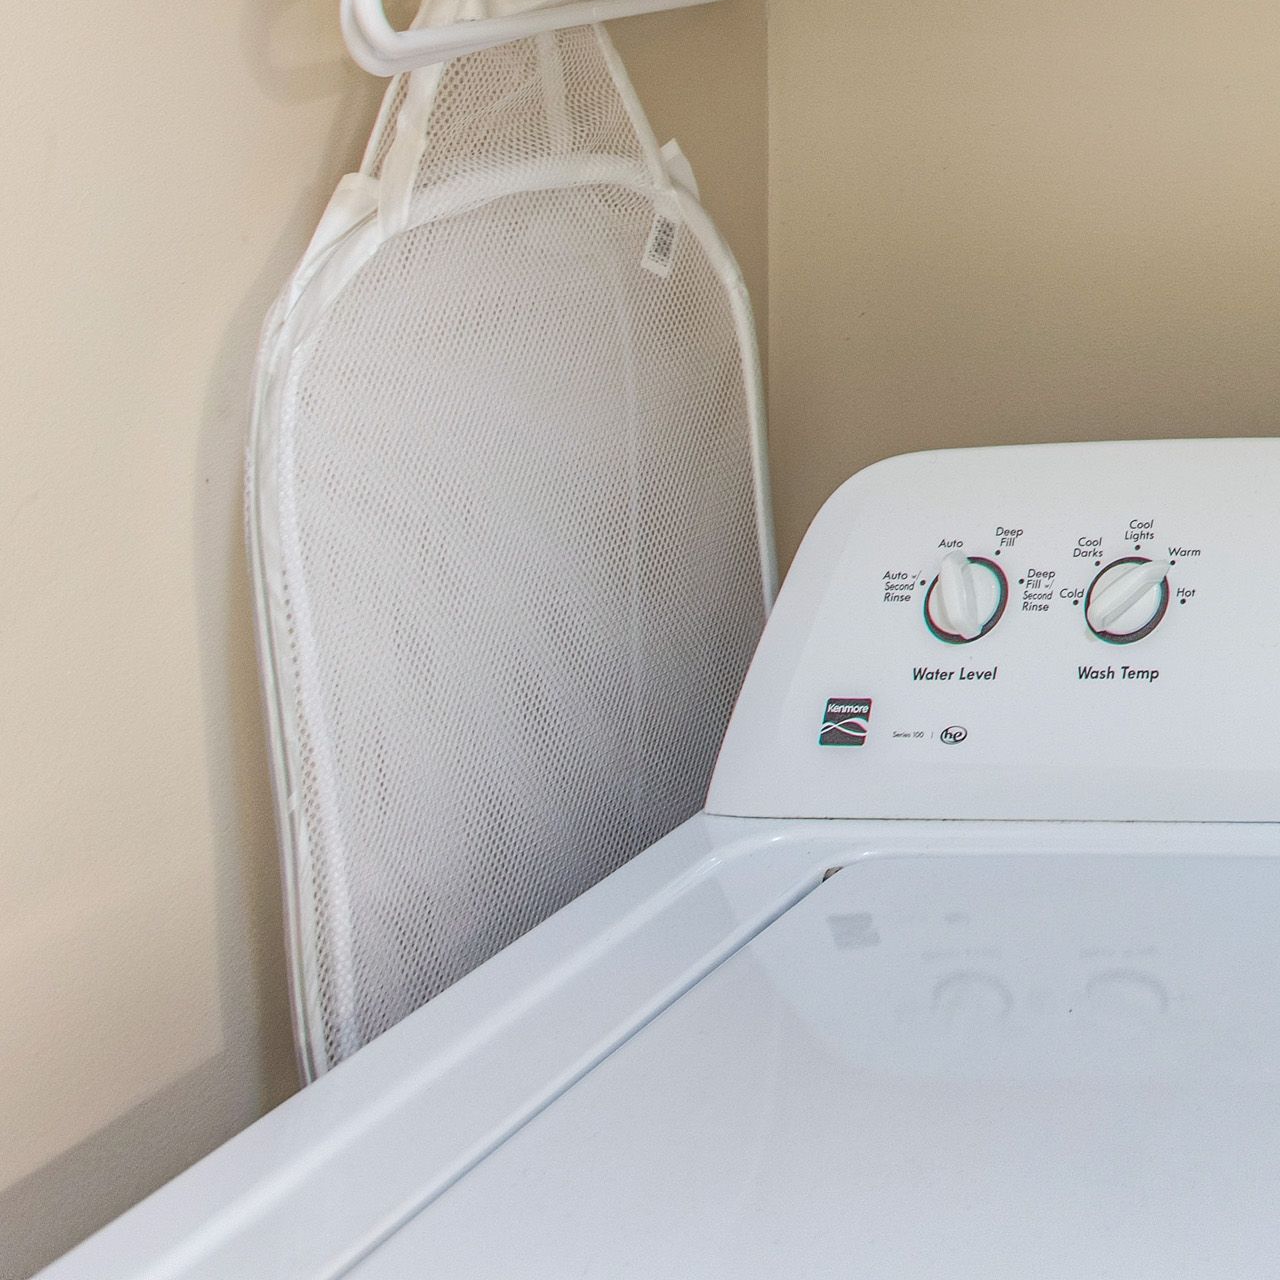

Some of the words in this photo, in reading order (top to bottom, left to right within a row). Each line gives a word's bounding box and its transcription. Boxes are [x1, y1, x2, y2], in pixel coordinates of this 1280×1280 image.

[1129, 519, 1155, 530] Cool
[995, 526, 1024, 539] Deep
[1124, 531, 1155, 543] Lights
[937, 538, 964, 548] Auto
[1000, 537, 1016, 547] Fill
[1078, 536, 1102, 547] Cool
[1072, 547, 1104, 558] Darks
[1167, 547, 1201, 556] Warm
[882, 570, 908, 580] Auto
[1027, 568, 1056, 579] Deep
[884, 581, 916, 591] Second
[1025, 579, 1041, 589] Fill
[883, 592, 912, 603] Rinse
[1022, 590, 1053, 601] Second
[1059, 588, 1085, 599] Cold
[1176, 587, 1196, 598] Hot
[1022, 601, 1049, 612] Rinse
[912, 667, 955, 681] Water
[958, 666, 998, 681] Level
[1077, 665, 1115, 680] Wash
[1120, 666, 1160, 683] Temp
[826, 703, 869, 714] Kenmore
